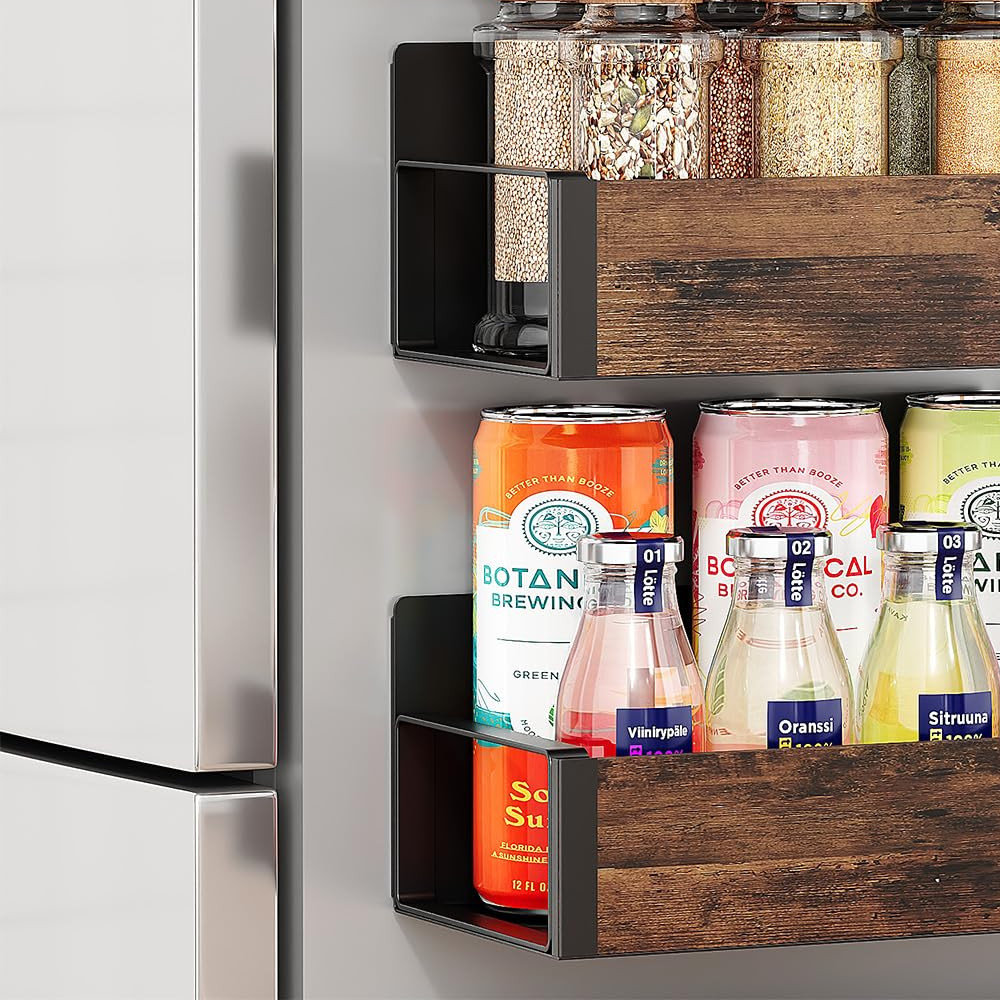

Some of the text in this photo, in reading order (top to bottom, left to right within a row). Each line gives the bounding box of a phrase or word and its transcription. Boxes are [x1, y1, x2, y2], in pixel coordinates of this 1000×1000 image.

[734, 468, 770, 491] BETTER
[809, 468, 844, 488] BOOZE
[943, 463, 978, 485] BETTER
[505, 477, 540, 500] BETTER
[578, 478, 615, 498] BOOZE
[792, 540, 811, 555] 02
[943, 534, 962, 550] 03
[644, 548, 660, 564] 01
[790, 562, 806, 602] Lötte
[942, 556, 957, 595] Lötte
[642, 570, 658, 606] Lötte
[831, 584, 862, 598] CO.
[513, 670, 559, 680] GREEN
[778, 717, 834, 734] Oranssi
[928, 710, 988, 726] Sitruuna
[628, 724, 688, 740] Viinirypäle
[500, 842, 542, 852] FLORIDA
[512, 880, 522, 890] 12
[526, 881, 536, 892] FL
